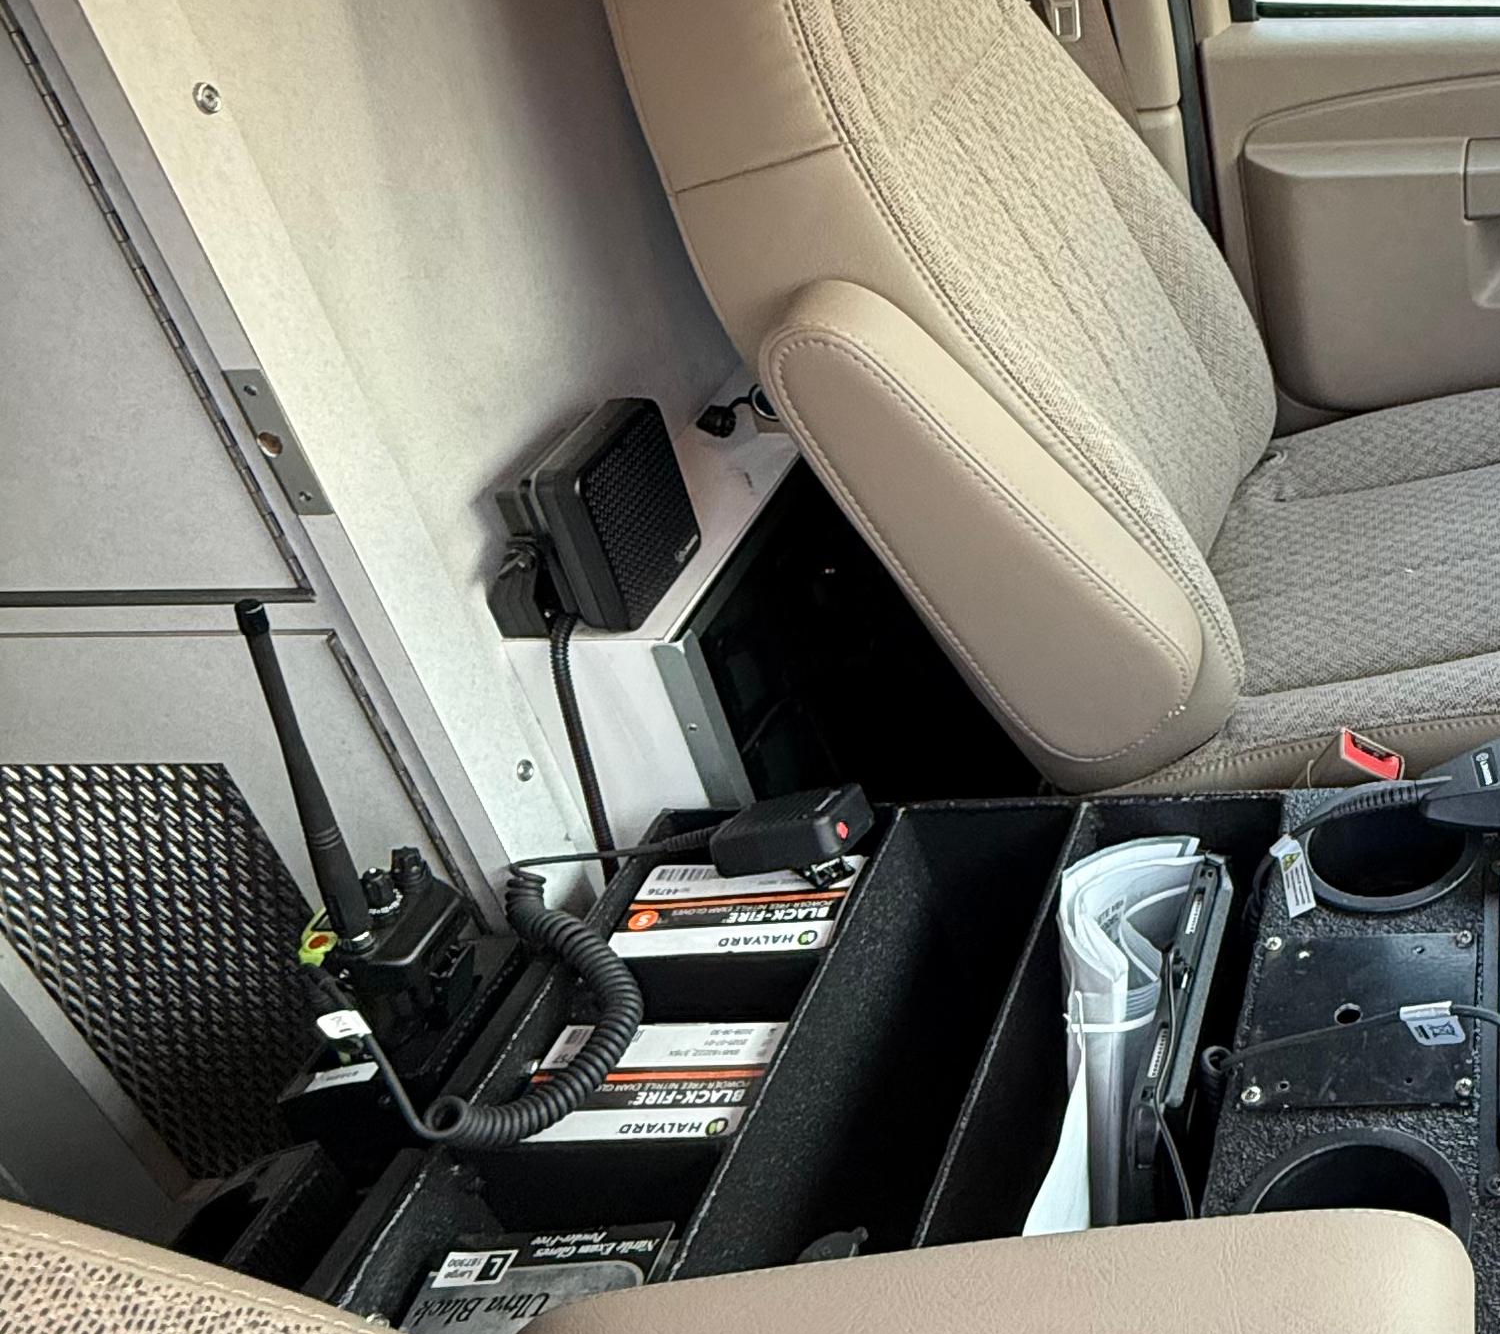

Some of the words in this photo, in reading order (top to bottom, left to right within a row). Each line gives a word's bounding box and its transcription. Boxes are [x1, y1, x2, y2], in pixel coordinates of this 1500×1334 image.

[706, 905, 733, 915] EXAM
[728, 906, 829, 924] BLACK-FIRE
[637, 914, 650, 927] S
[718, 933, 795, 947] HALYARD
[615, 1084, 643, 1093] EXAM
[643, 1083, 679, 1092] NITRILE
[634, 1088, 745, 1105] BLACK-FIRE
[618, 1120, 702, 1135] HALYARD
[530, 1230, 607, 1246] Powder-Free
[533, 1245, 578, 1259] Gloves
[578, 1242, 615, 1256] Exam
[616, 1238, 660, 1254] Nitrile
[443, 1268, 473, 1281] Large
[413, 1296, 484, 1328] Black
[488, 1292, 550, 1320] Ultra
